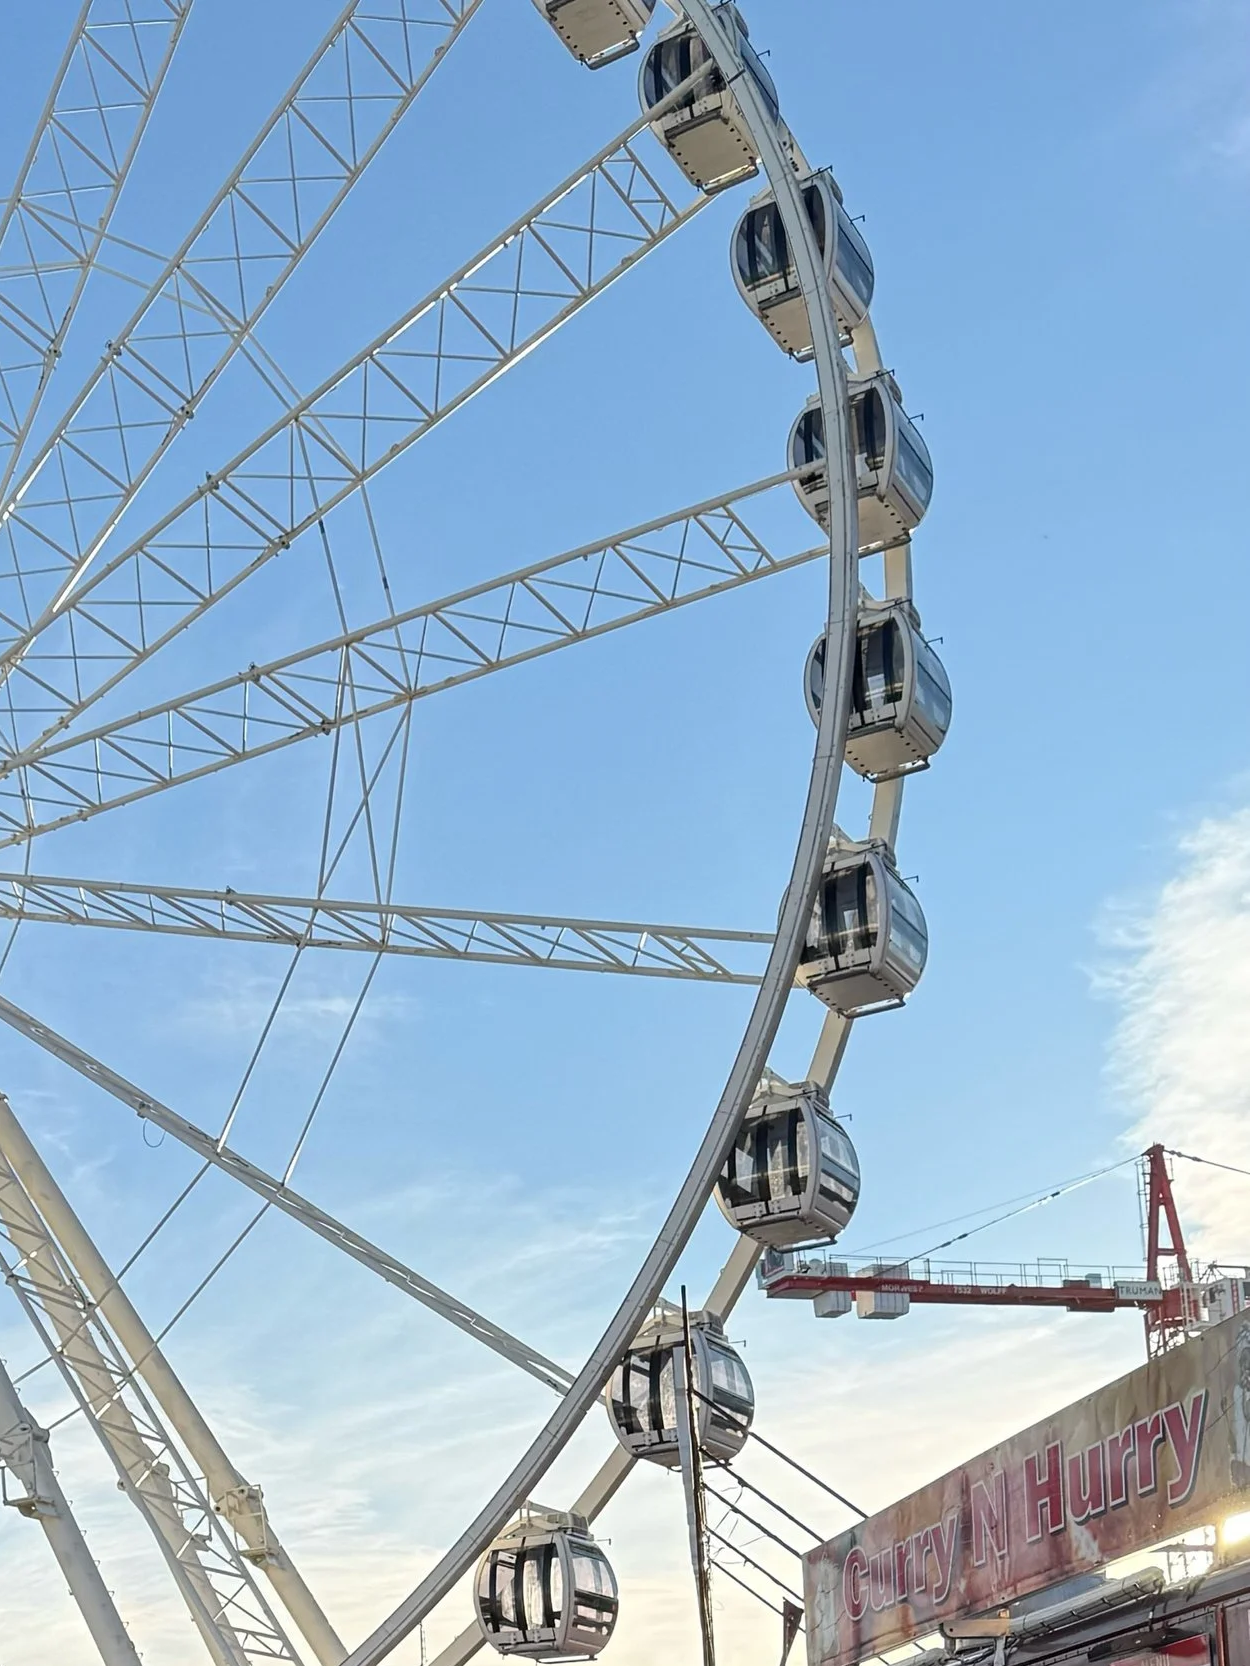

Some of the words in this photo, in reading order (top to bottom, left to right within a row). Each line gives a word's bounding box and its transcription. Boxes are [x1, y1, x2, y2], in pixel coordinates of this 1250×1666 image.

[953, 1286, 972, 1294] 7532
[979, 1286, 1007, 1295] WOLFF
[1119, 1285, 1162, 1296] TRUMAN
[842, 1513, 960, 1622] Curry
[970, 1469, 1008, 1567] N
[1023, 1387, 1209, 1544] Hurry
